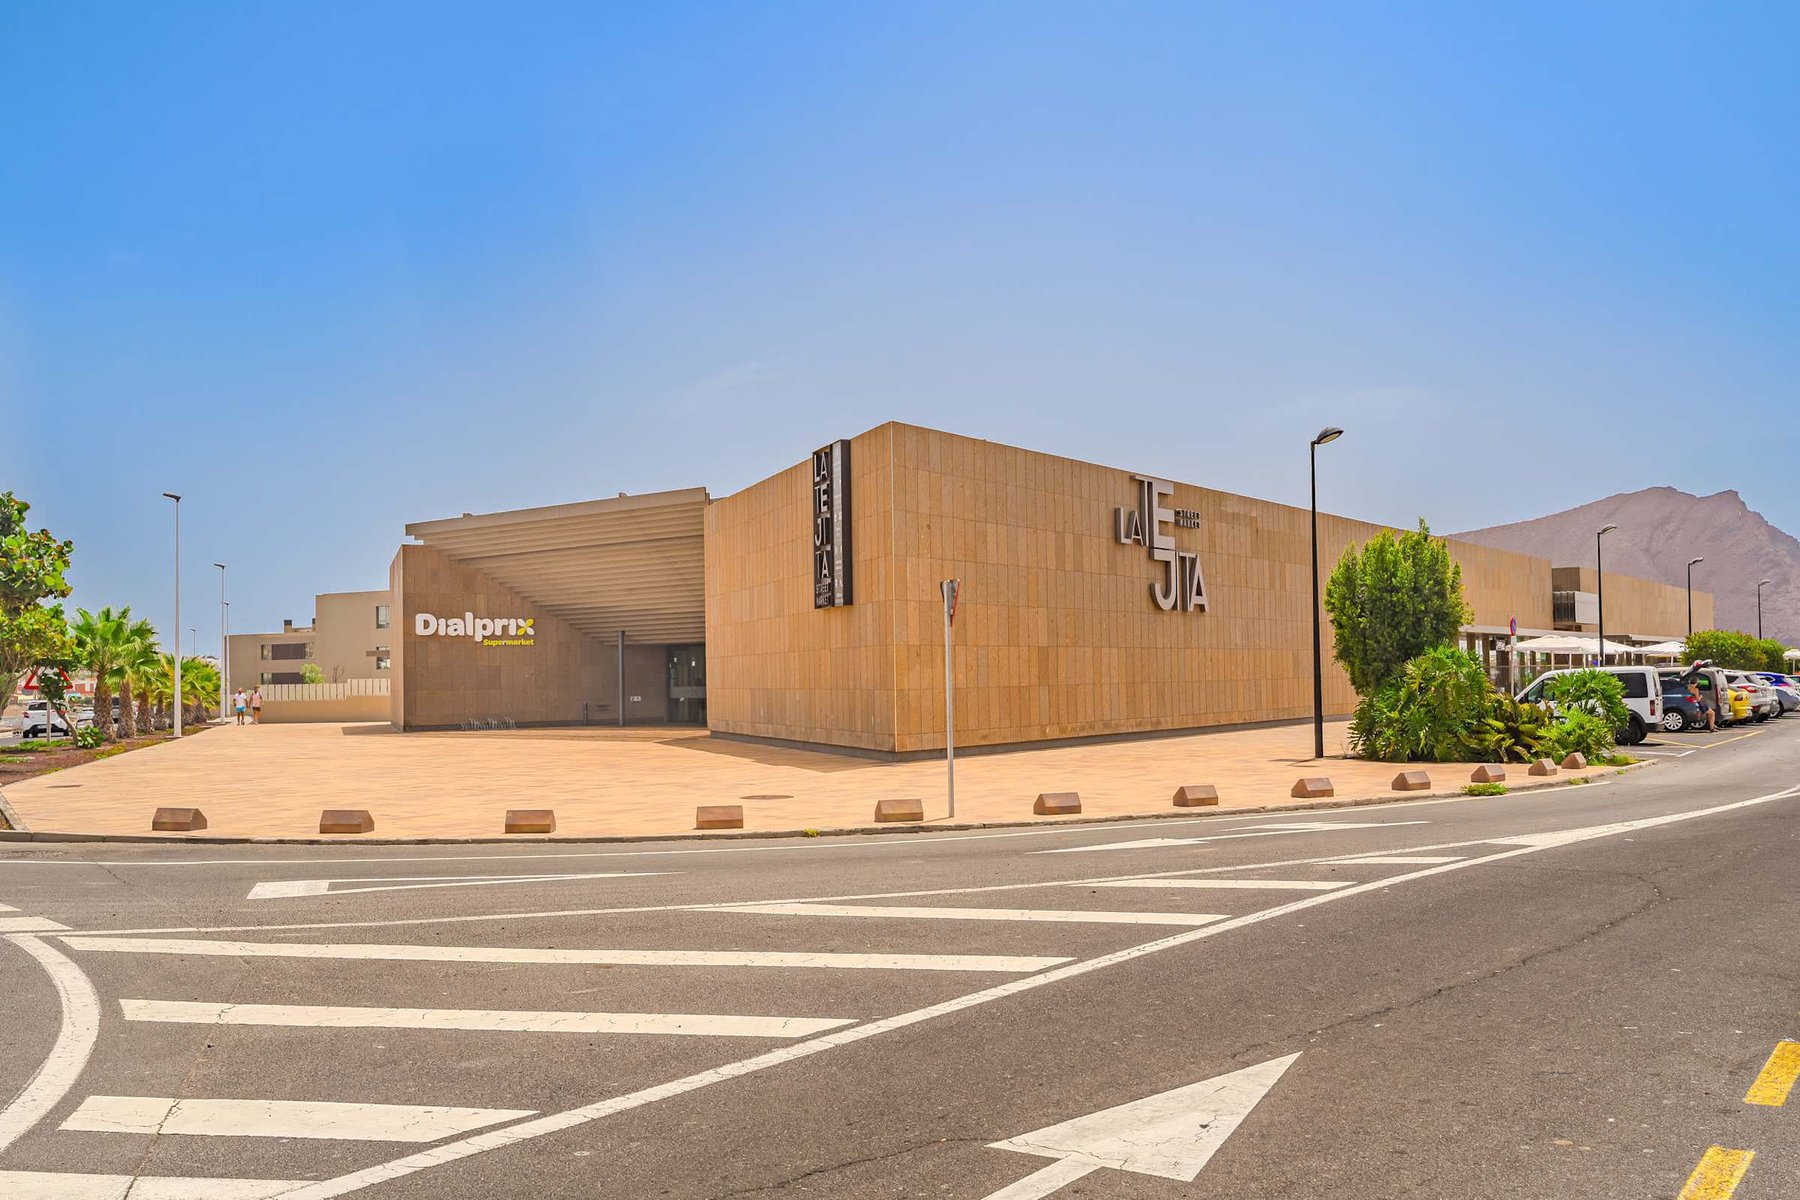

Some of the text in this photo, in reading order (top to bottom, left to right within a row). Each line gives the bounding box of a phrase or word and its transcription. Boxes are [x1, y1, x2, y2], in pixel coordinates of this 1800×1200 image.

[814, 451, 828, 482] LA
[814, 482, 828, 513] TE
[1117, 507, 1144, 546] LA
[815, 551, 829, 578] TA
[415, 611, 535, 642] Dialprix
[483, 638, 535, 647] Supermarket
